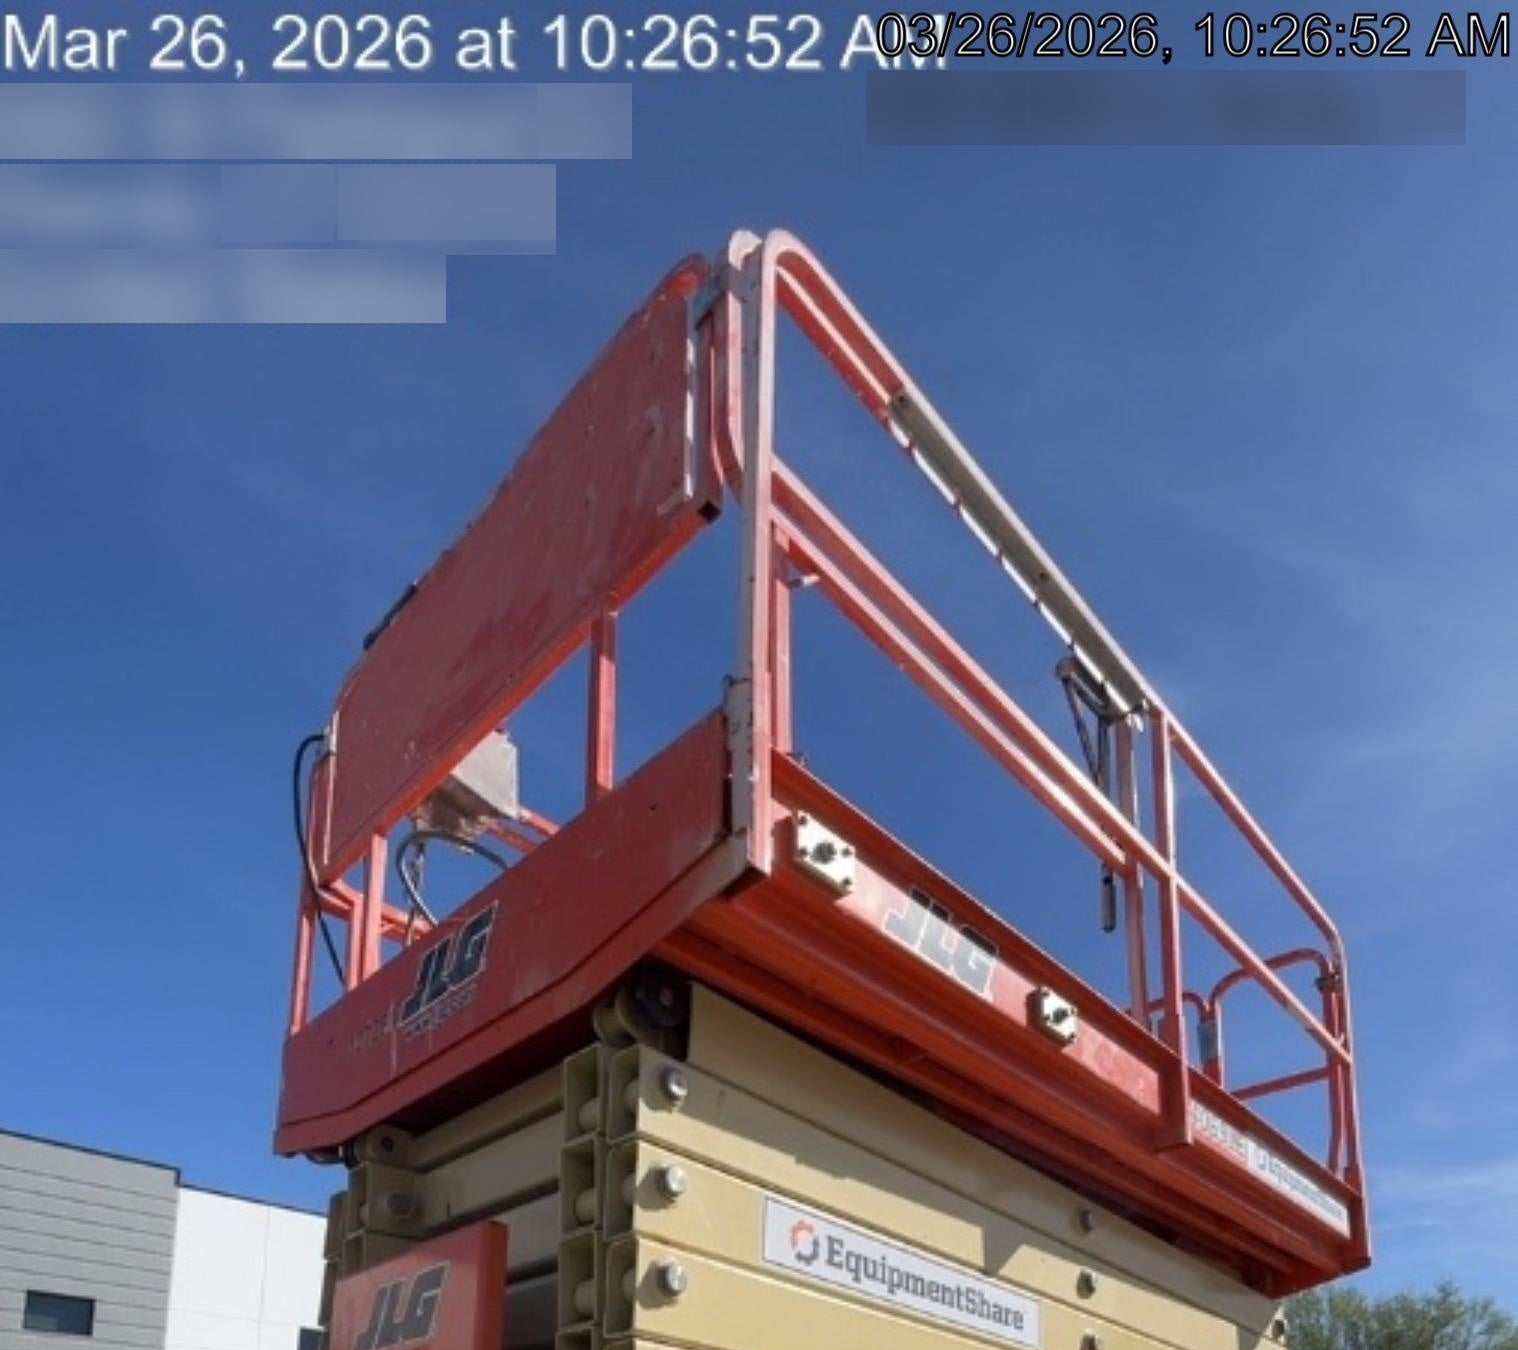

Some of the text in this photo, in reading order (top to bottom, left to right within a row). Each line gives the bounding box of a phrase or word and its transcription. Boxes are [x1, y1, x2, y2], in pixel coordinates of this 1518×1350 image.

[399, 902, 498, 1026] JLG
[883, 886, 998, 1001] JLG
[825, 1234, 1025, 1331] EquipmentShare
